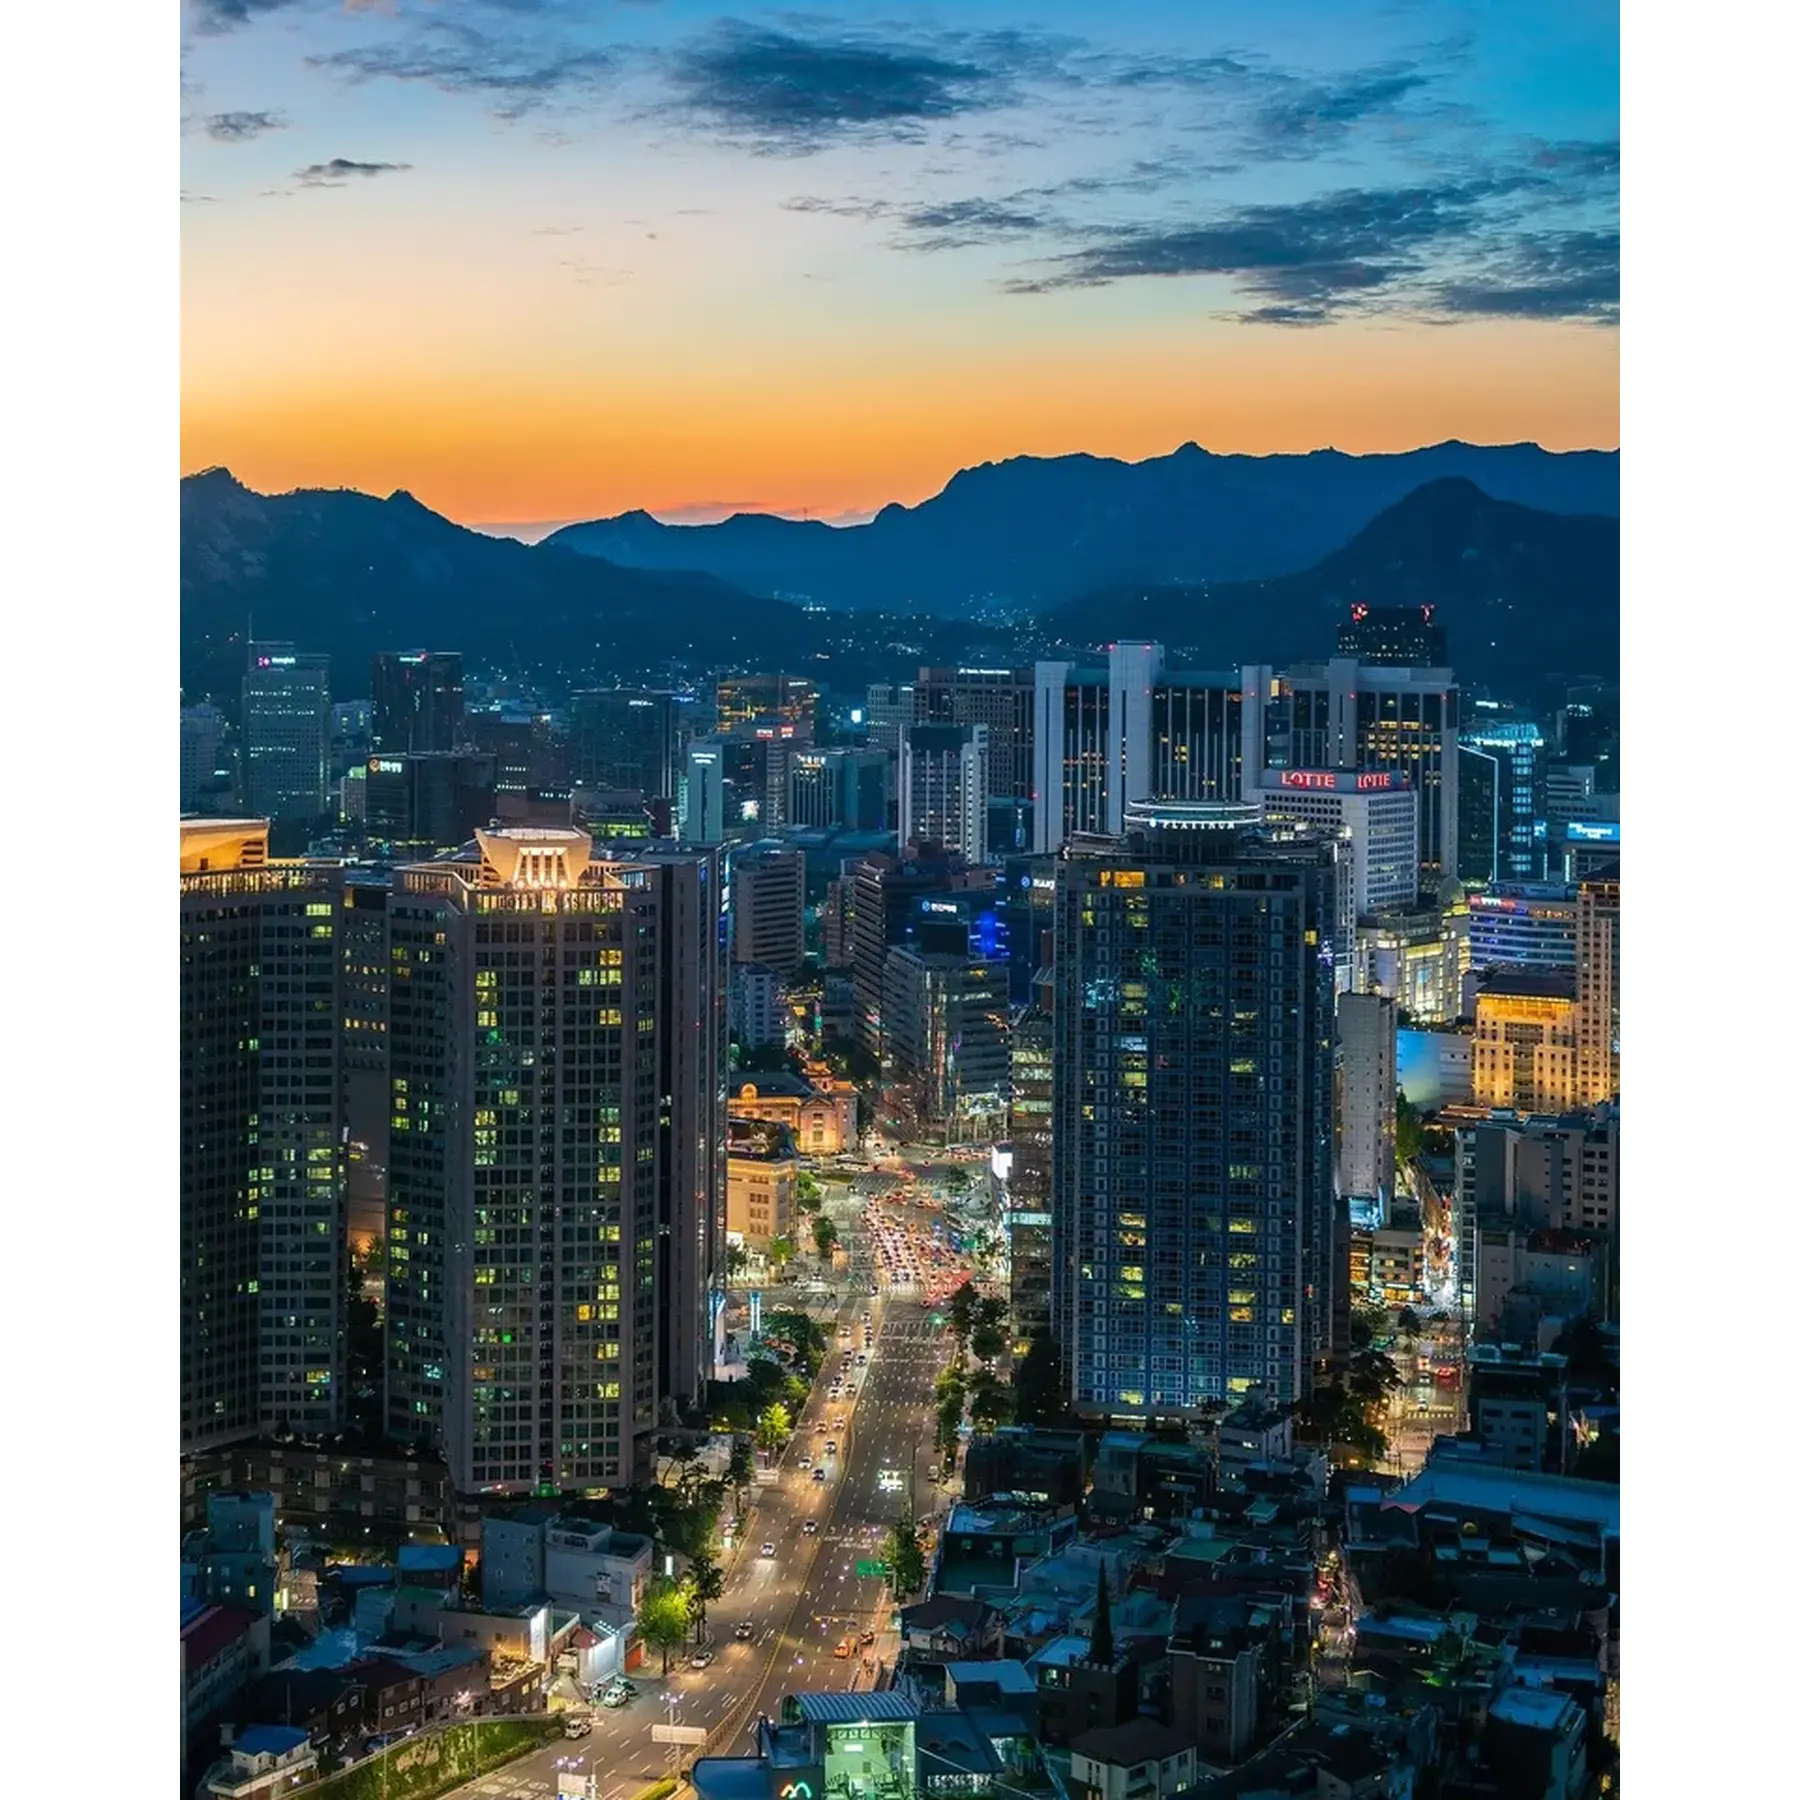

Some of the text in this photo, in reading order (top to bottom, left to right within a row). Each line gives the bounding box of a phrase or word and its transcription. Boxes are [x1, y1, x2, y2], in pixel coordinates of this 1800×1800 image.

[1281, 772, 1335, 788] LOTTE
[1358, 772, 1390, 788] LOTTE
[1163, 820, 1235, 830] PLATINUM
